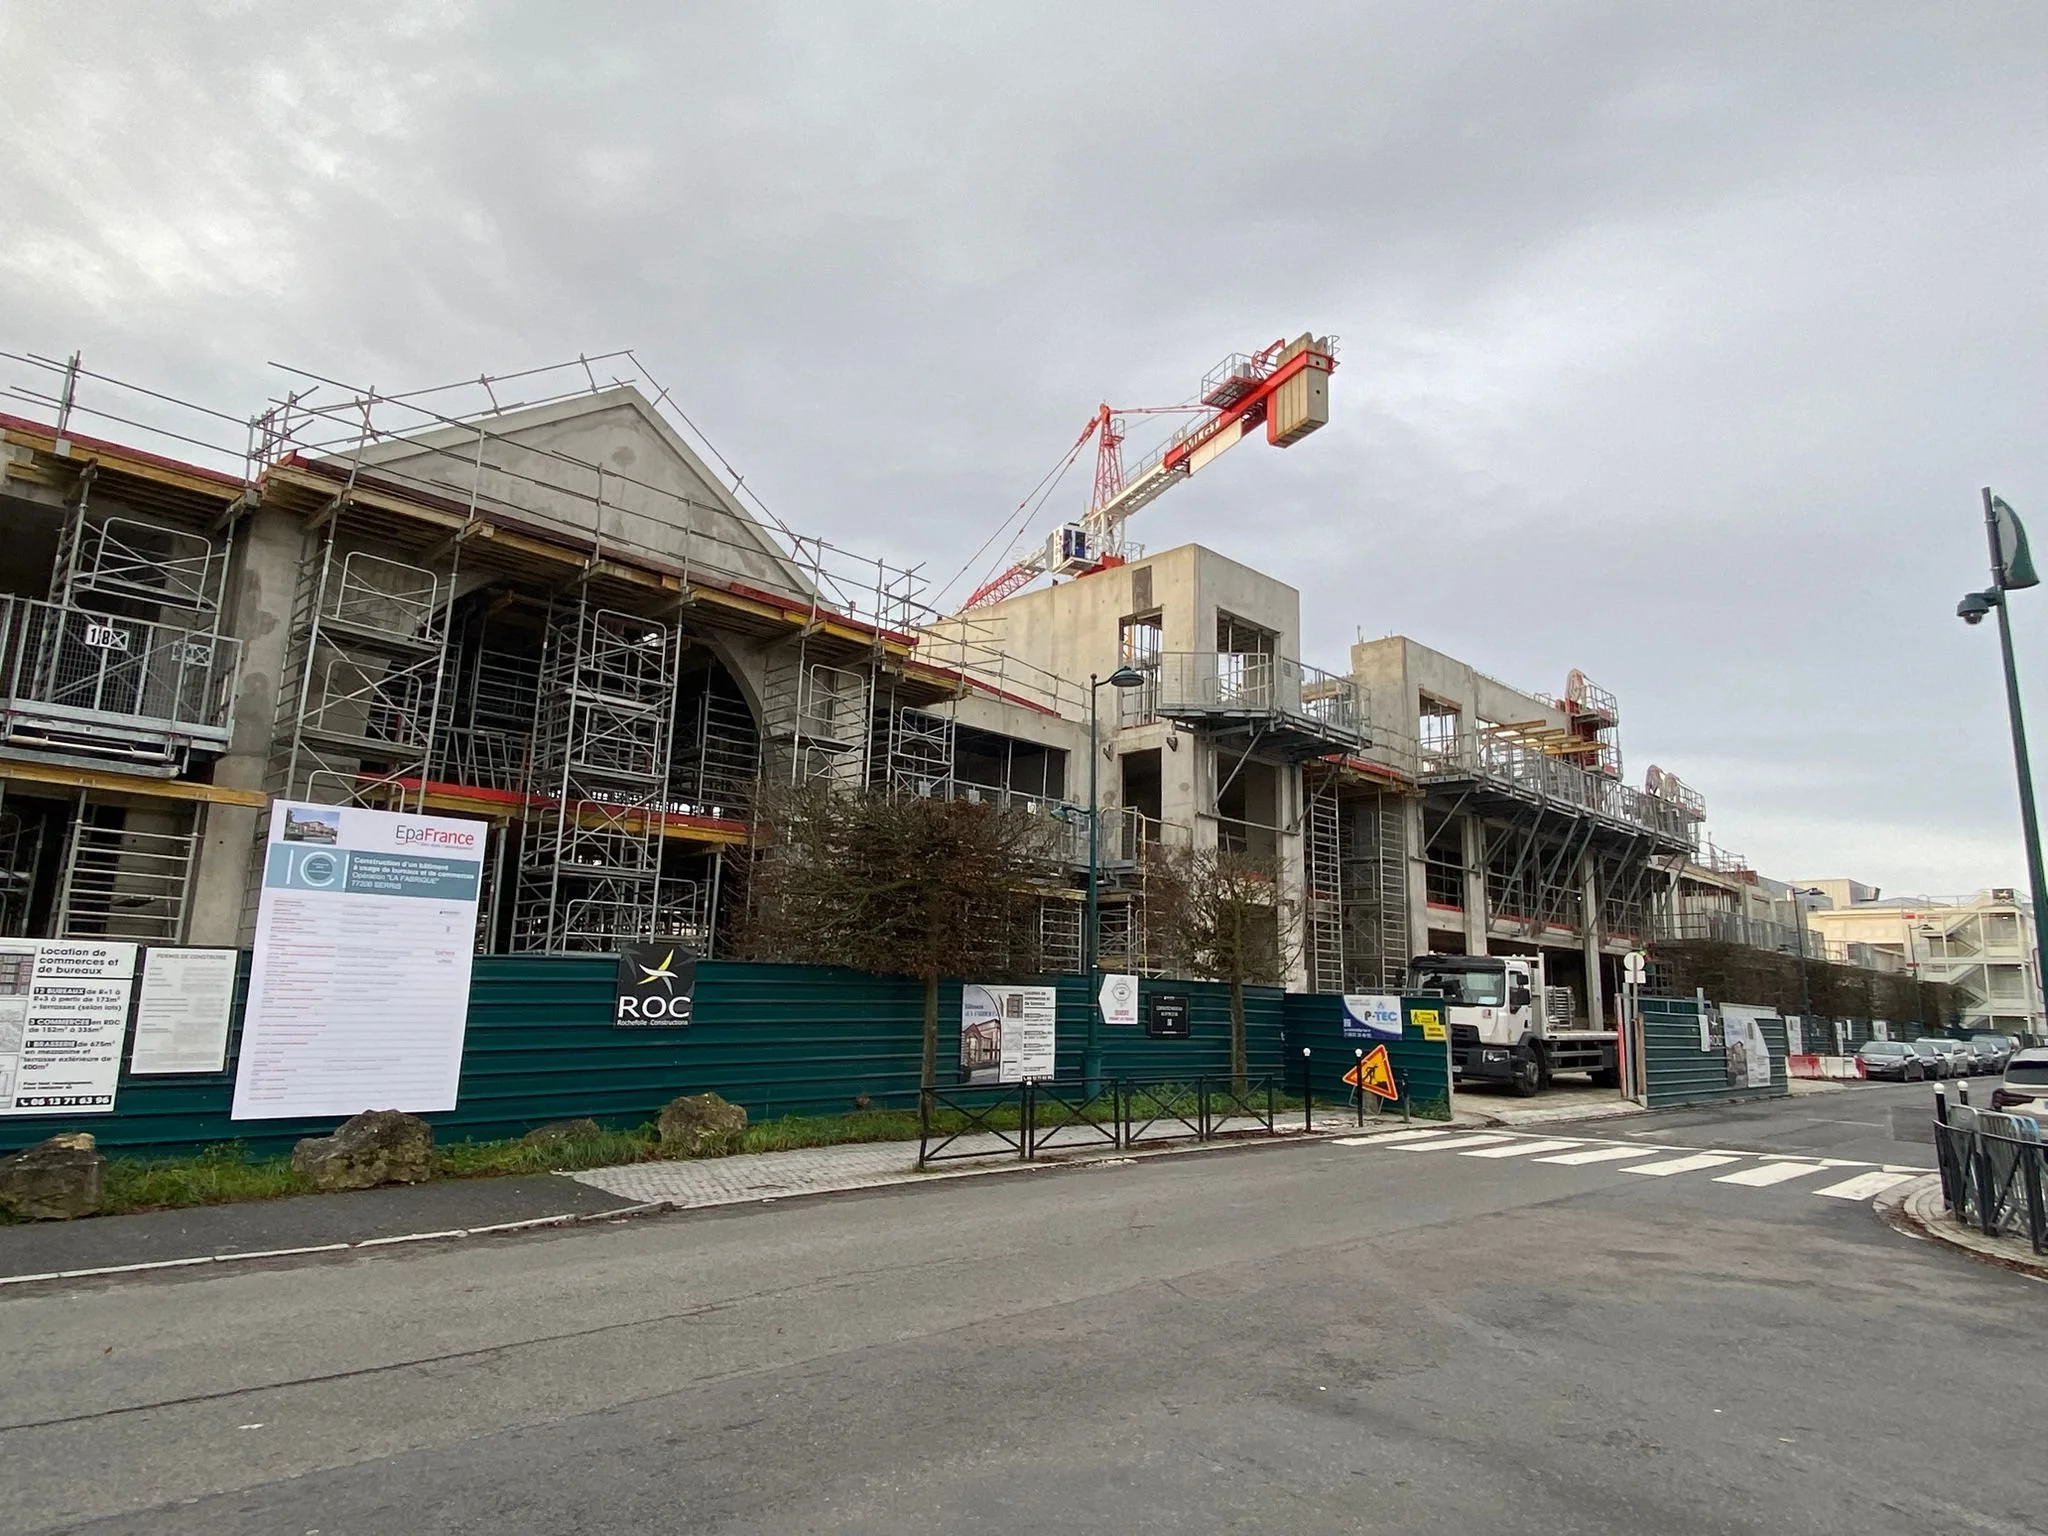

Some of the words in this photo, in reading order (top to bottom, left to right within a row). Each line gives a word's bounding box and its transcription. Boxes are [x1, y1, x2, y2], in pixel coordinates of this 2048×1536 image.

[395, 824, 475, 846] EpaFrance
[354, 857, 401, 867] Construction
[41, 947, 89, 956] Location
[92, 949, 107, 957] de
[39, 958, 105, 966] commerces
[37, 966, 53, 974] de
[56, 966, 103, 975] bureaux
[617, 996, 691, 1018] ROC
[1364, 1010, 1398, 1022] P-TEC
